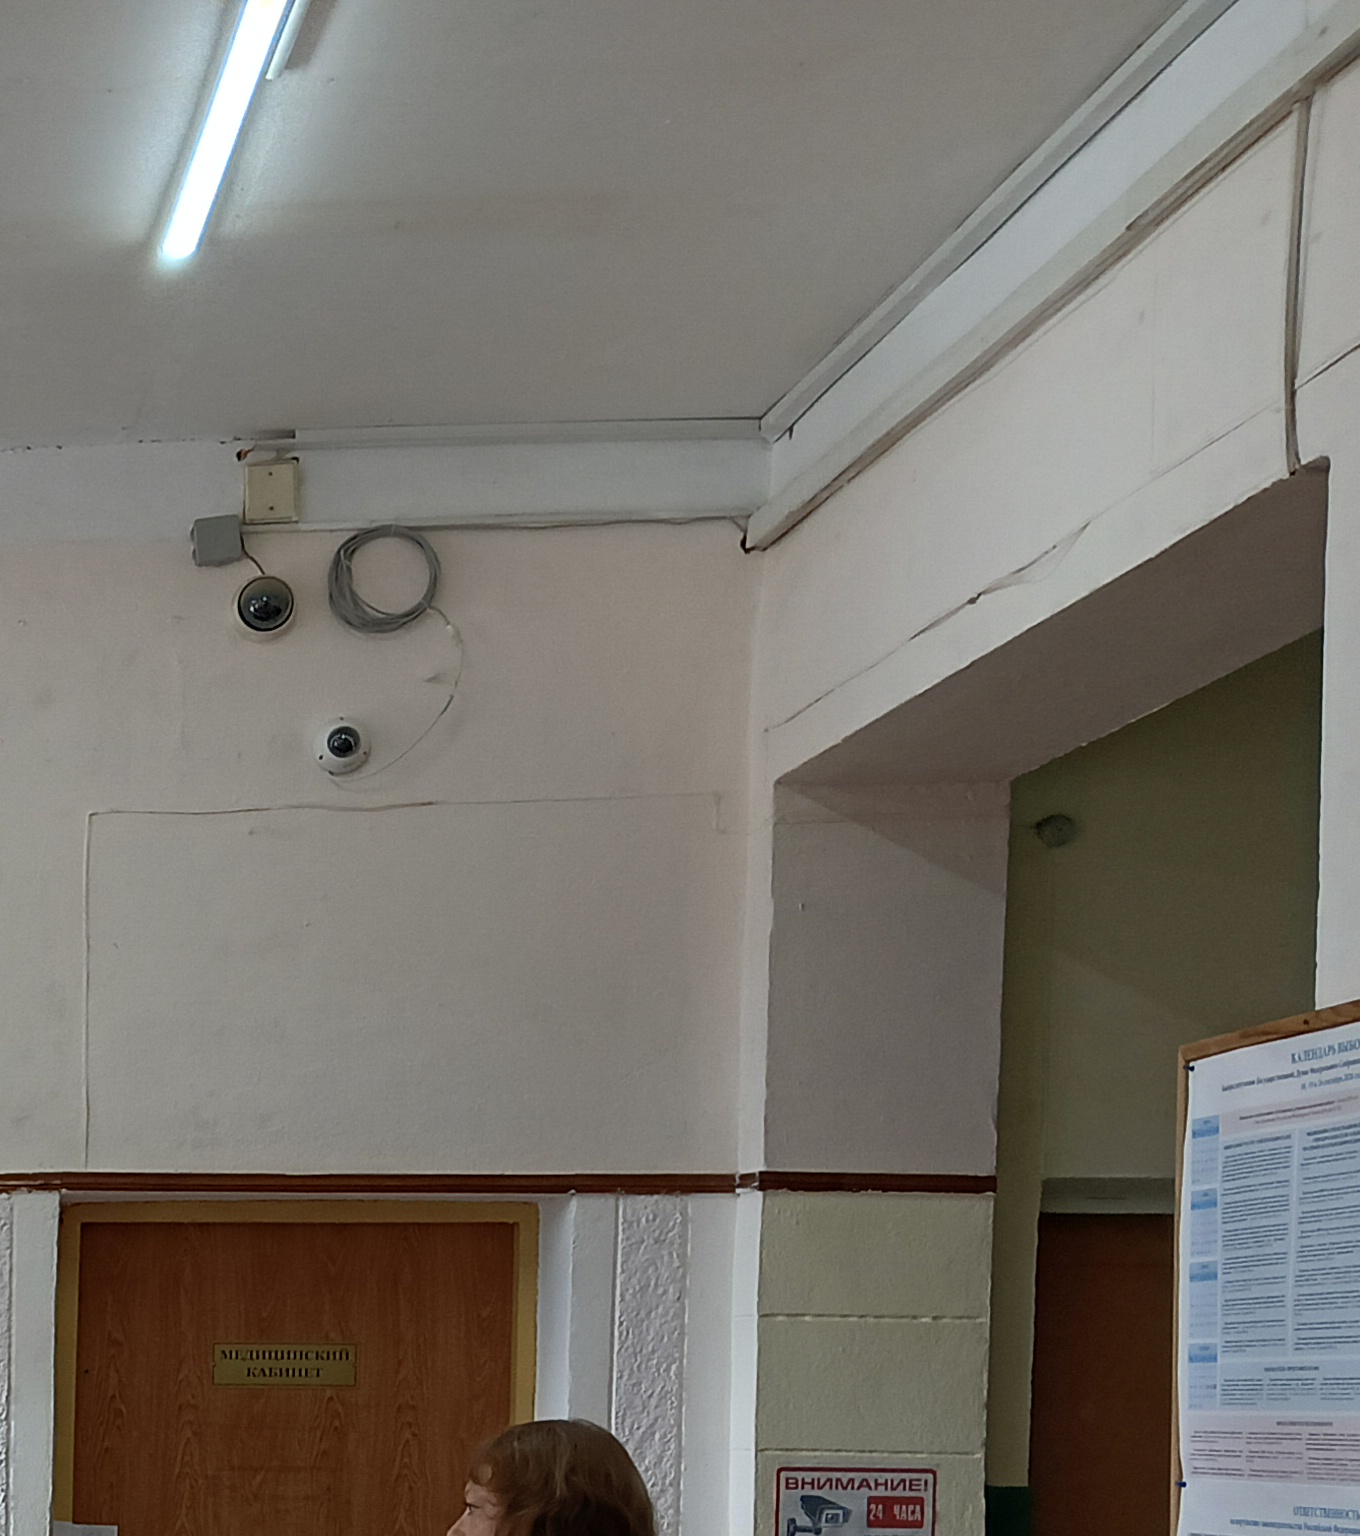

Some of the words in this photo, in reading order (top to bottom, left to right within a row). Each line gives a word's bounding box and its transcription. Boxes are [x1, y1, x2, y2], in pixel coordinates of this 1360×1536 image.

[220, 1348, 350, 1362] МЕДИЦИНСКИЙ
[246, 1367, 324, 1378] КАБИНЕТ
[785, 1477, 929, 1492] ВНИМАНИЕ!
[869, 1504, 883, 1520] 24
[893, 1504, 922, 1521] ЧАСА
